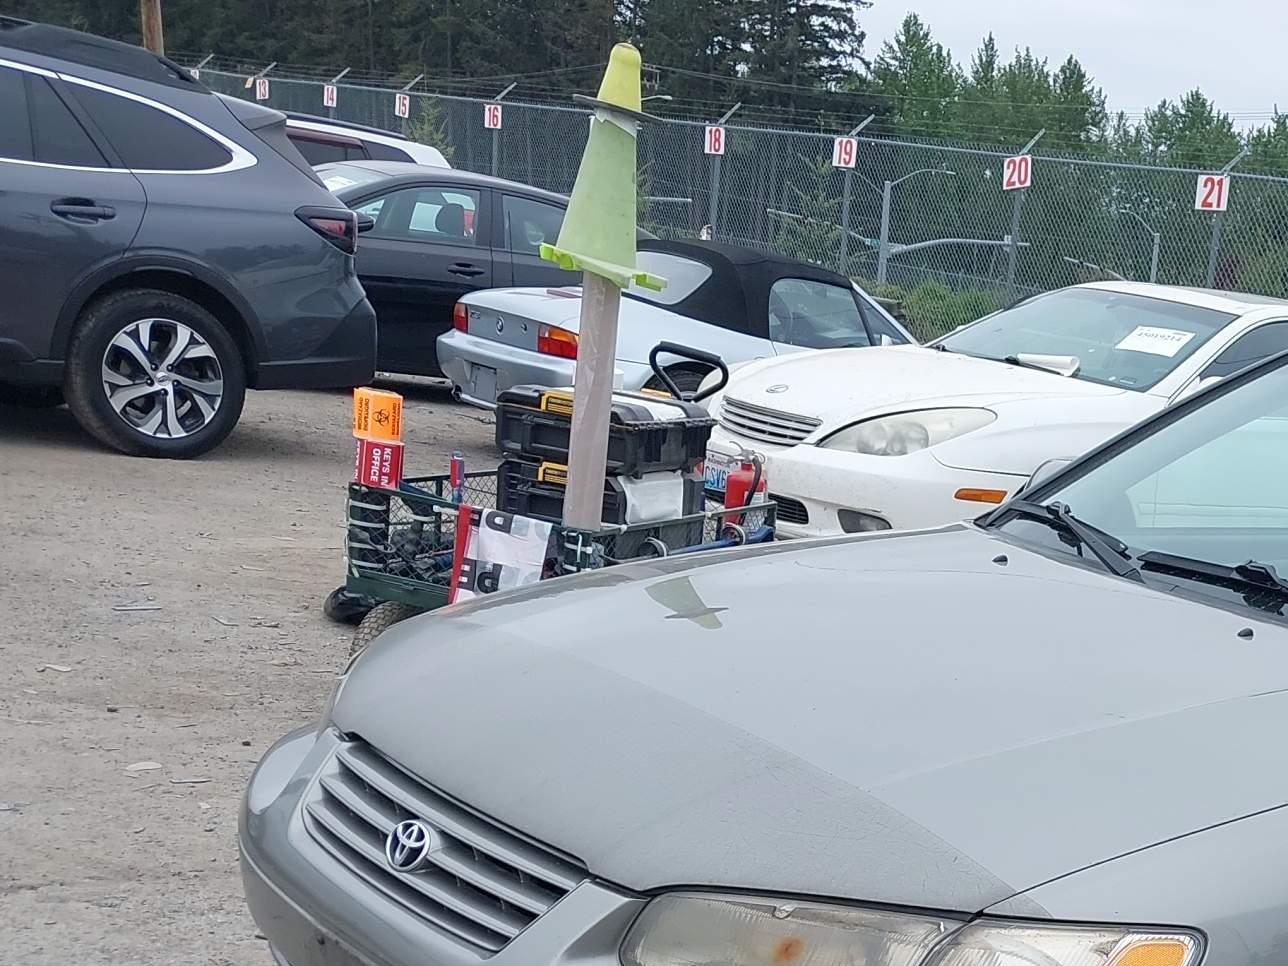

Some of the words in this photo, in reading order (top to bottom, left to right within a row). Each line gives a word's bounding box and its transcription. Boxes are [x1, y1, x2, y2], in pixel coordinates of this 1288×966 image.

[258, 81, 267, 98] 13
[326, 87, 335, 105] 14
[398, 95, 407, 116] 15
[487, 106, 499, 127] 16
[708, 127, 722, 153] 18
[836, 139, 853, 166] 19
[1005, 157, 1029, 188] 20
[1200, 176, 1225, 209] 21
[370, 448, 381, 482] OFFICE
[382, 448, 392, 473] KEYS
[380, 475, 389, 487] IN
[705, 466, 730, 488] CSV6
